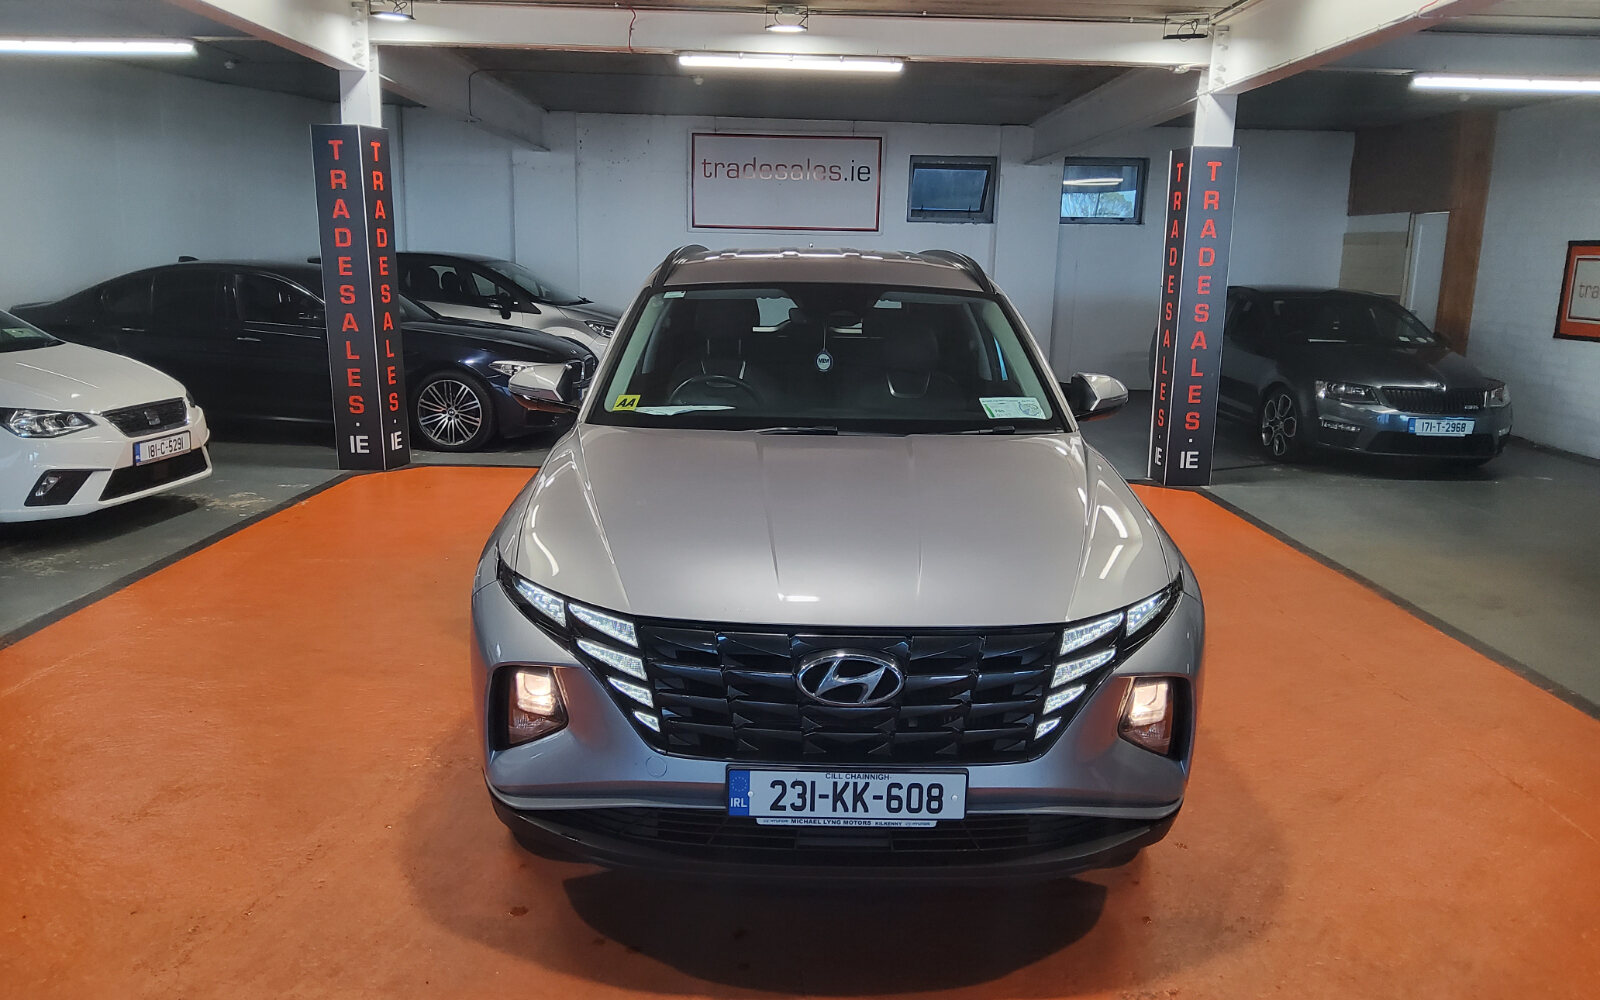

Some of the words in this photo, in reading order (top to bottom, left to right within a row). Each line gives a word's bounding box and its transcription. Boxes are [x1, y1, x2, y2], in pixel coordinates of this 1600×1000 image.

[701, 157, 871, 182] tradesales.ie
[616, 398, 636, 407] AA
[1421, 421, 1467, 433] 171-T-2968
[147, 437, 184, 459] 181-C-5291
[845, 773, 890, 781] CHAINNIGH
[730, 797, 748, 808] IRL
[769, 779, 944, 815] 231-KK-608
[843, 819, 872, 827] MOTORS
